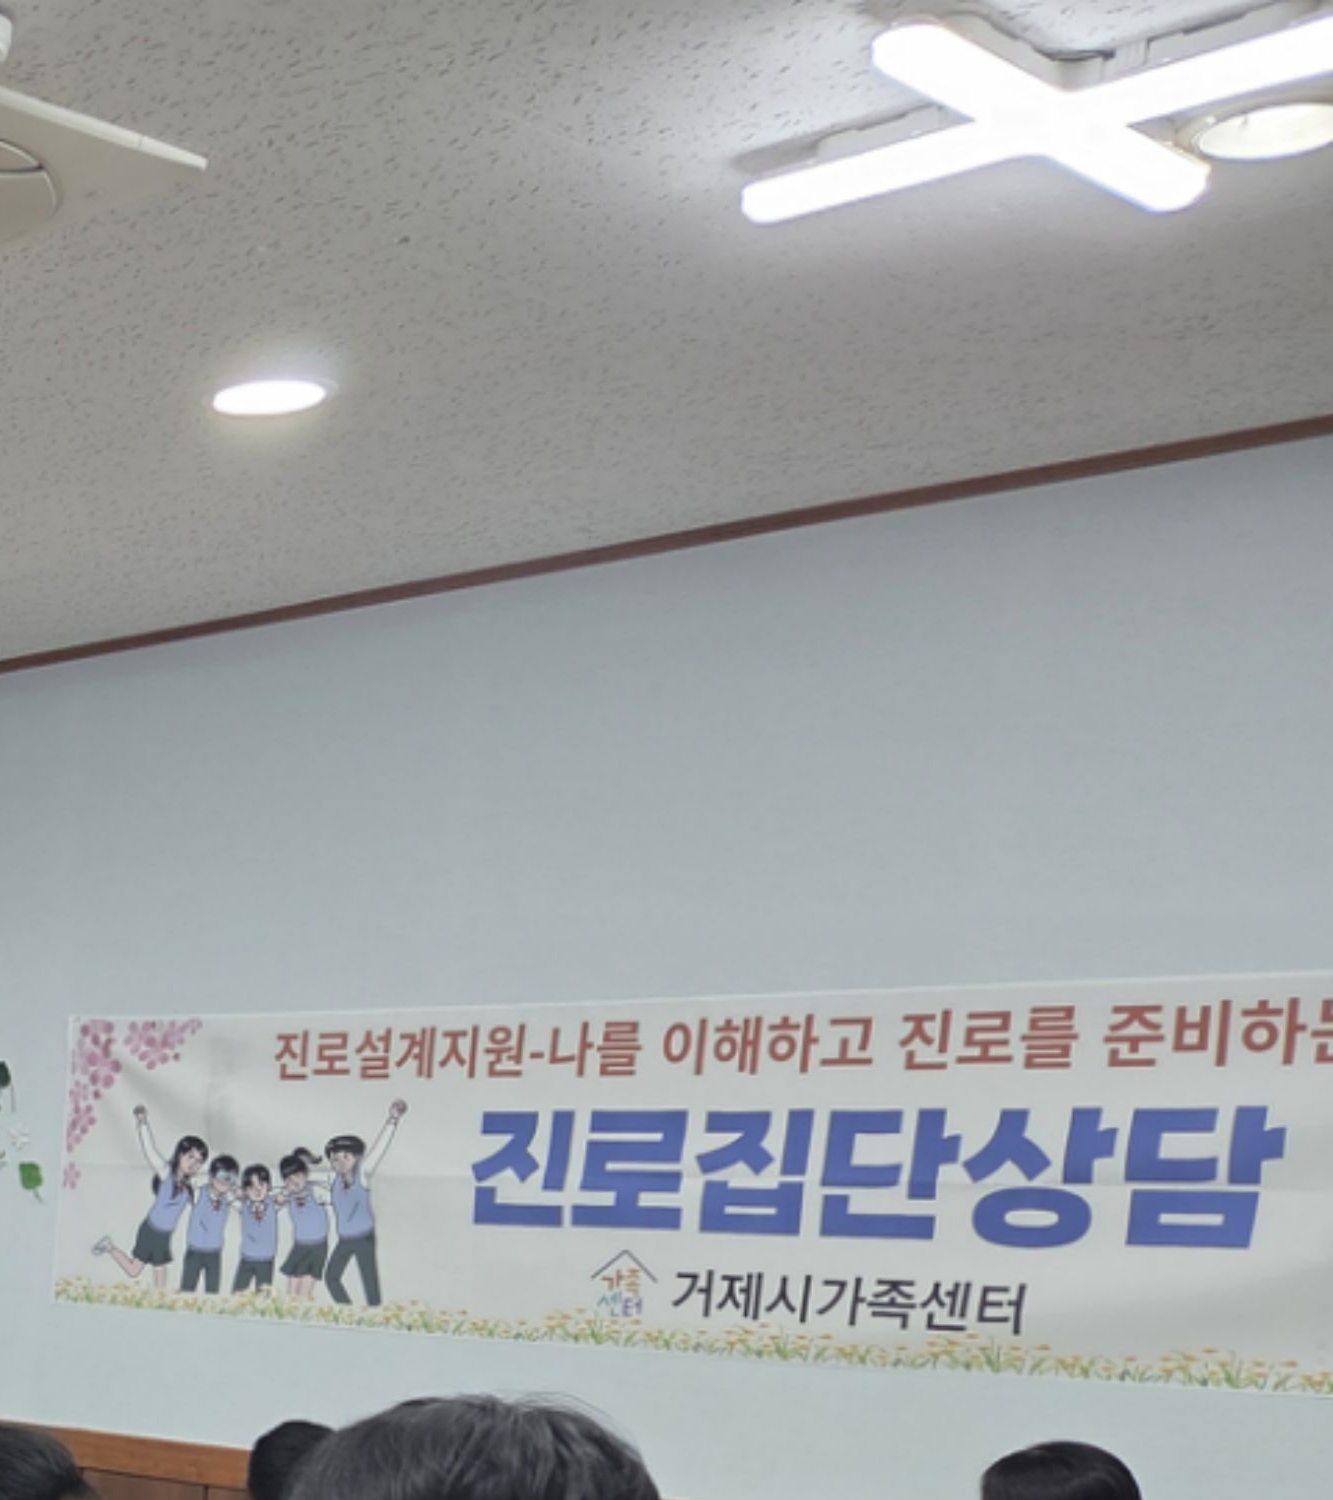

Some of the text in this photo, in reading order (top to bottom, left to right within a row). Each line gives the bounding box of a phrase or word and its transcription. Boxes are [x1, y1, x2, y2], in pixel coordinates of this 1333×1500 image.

[274, 1021, 643, 1081] 진로설계지원-나를
[663, 1014, 874, 1075] 이해하고
[898, 1006, 1080, 1071] 진로를
[470, 1105, 1287, 1250] 진로집단상담
[596, 1290, 643, 1317] 센터
[600, 1268, 642, 1297] 가족
[671, 1269, 1028, 1335] 거제시가족센터
